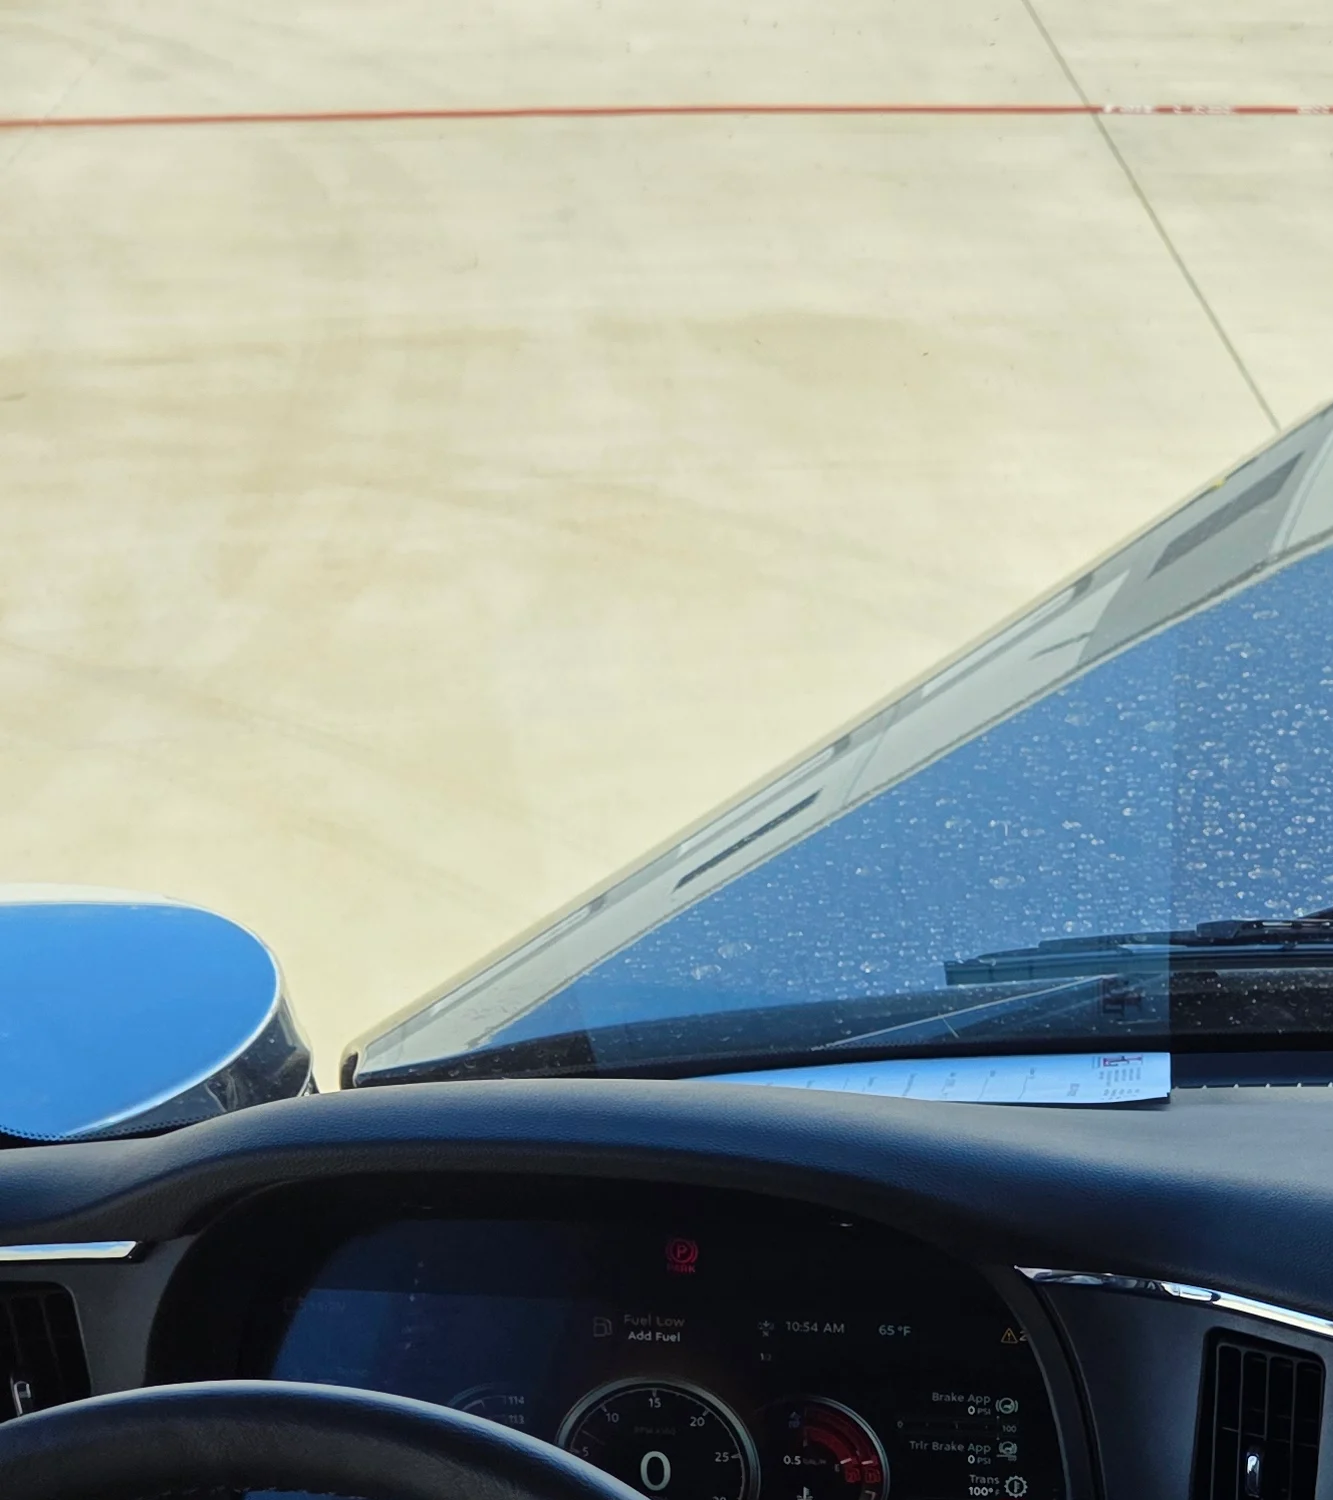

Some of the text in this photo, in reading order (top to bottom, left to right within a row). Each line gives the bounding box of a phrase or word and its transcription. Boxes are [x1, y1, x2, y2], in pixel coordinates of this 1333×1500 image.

[666, 1263, 697, 1274] PARK
[623, 1313, 686, 1328] Fuel Low
[785, 1320, 845, 1334] 10:54 AM
[878, 1324, 896, 1336] 65
[628, 1331, 681, 1343] Add Fuel
[648, 1398, 662, 1408] 15
[931, 1392, 992, 1406] Brake App
[967, 1405, 991, 1416] 0 PSI
[605, 1412, 620, 1423] 10
[689, 1416, 706, 1427] 20
[1002, 1425, 1018, 1433] 100
[582, 1446, 589, 1456] 5
[931, 1441, 965, 1452] Brake
[967, 1442, 992, 1455] App
[714, 1452, 730, 1463] 25
[783, 1455, 801, 1466] 0.5
[967, 1454, 991, 1465] 0 PSI
[640, 1450, 671, 1491] 0
[969, 1474, 1000, 1485] Trans
